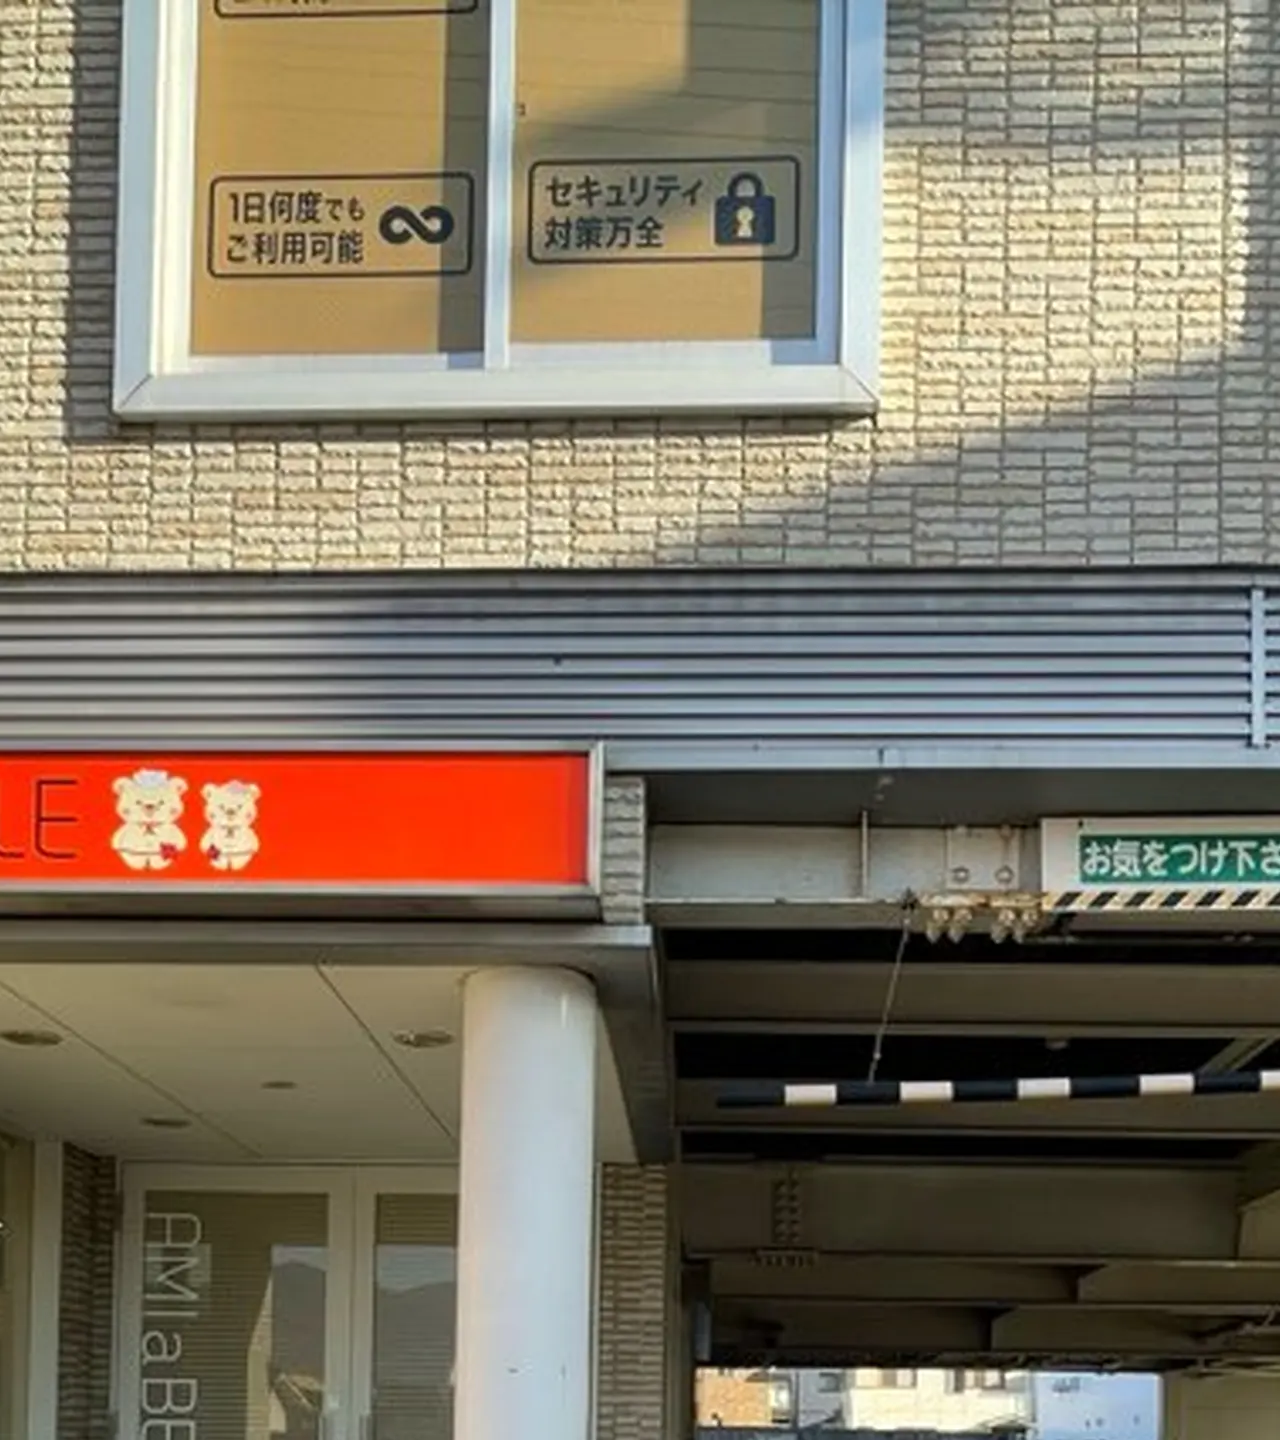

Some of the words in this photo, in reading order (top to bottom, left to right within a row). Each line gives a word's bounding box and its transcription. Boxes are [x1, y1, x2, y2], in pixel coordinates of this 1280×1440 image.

[228, 190, 366, 224] 1日何度でも
[545, 174, 704, 208] セキュリティ
[226, 229, 365, 265] ご利用可能
[544, 215, 664, 250] 対策万全
[144, 1211, 202, 1317] AMI
[142, 1330, 182, 1365] a
